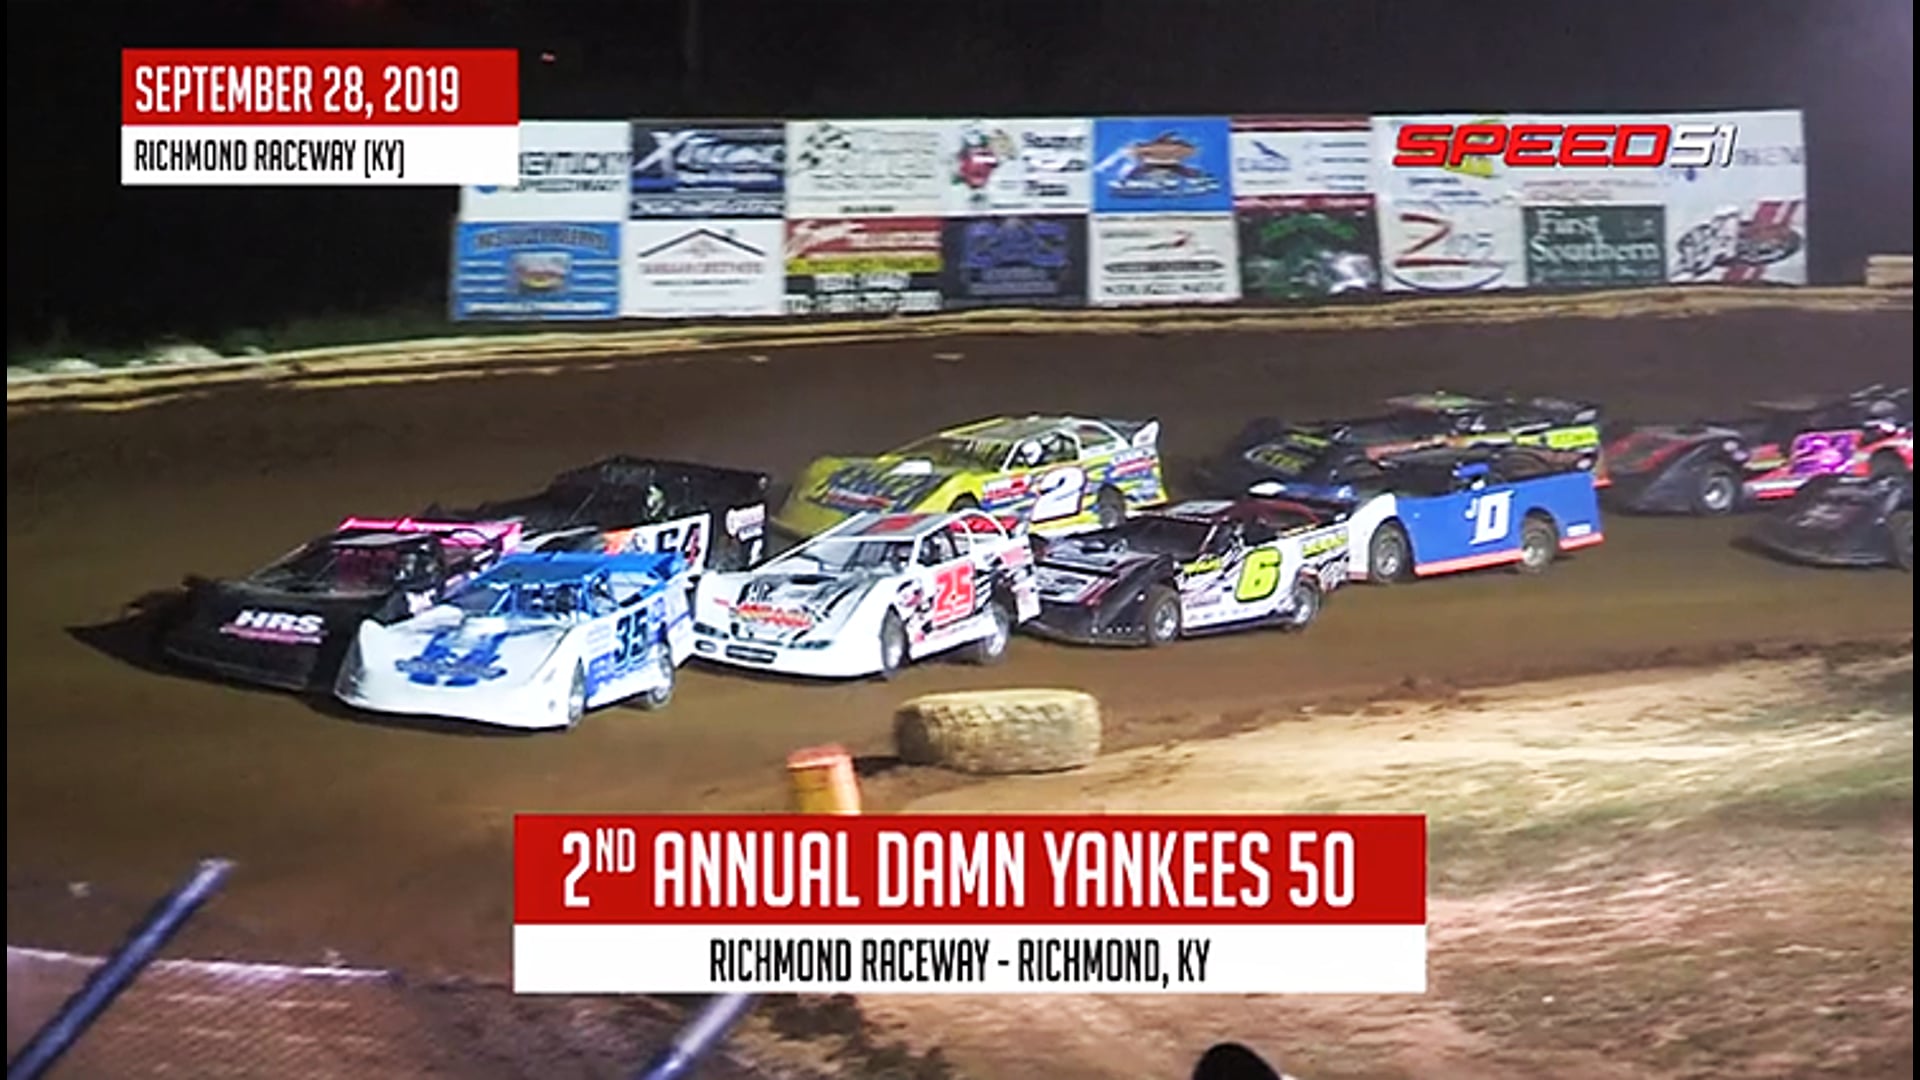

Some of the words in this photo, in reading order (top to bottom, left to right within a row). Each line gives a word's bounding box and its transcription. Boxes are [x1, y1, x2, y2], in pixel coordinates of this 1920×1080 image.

[1529, 234, 1660, 264] Southern
[1030, 466, 1086, 523] 2
[934, 562, 975, 612] 25
[1235, 546, 1283, 603] 6
[234, 608, 325, 635] HRS
[613, 606, 649, 663] 35
